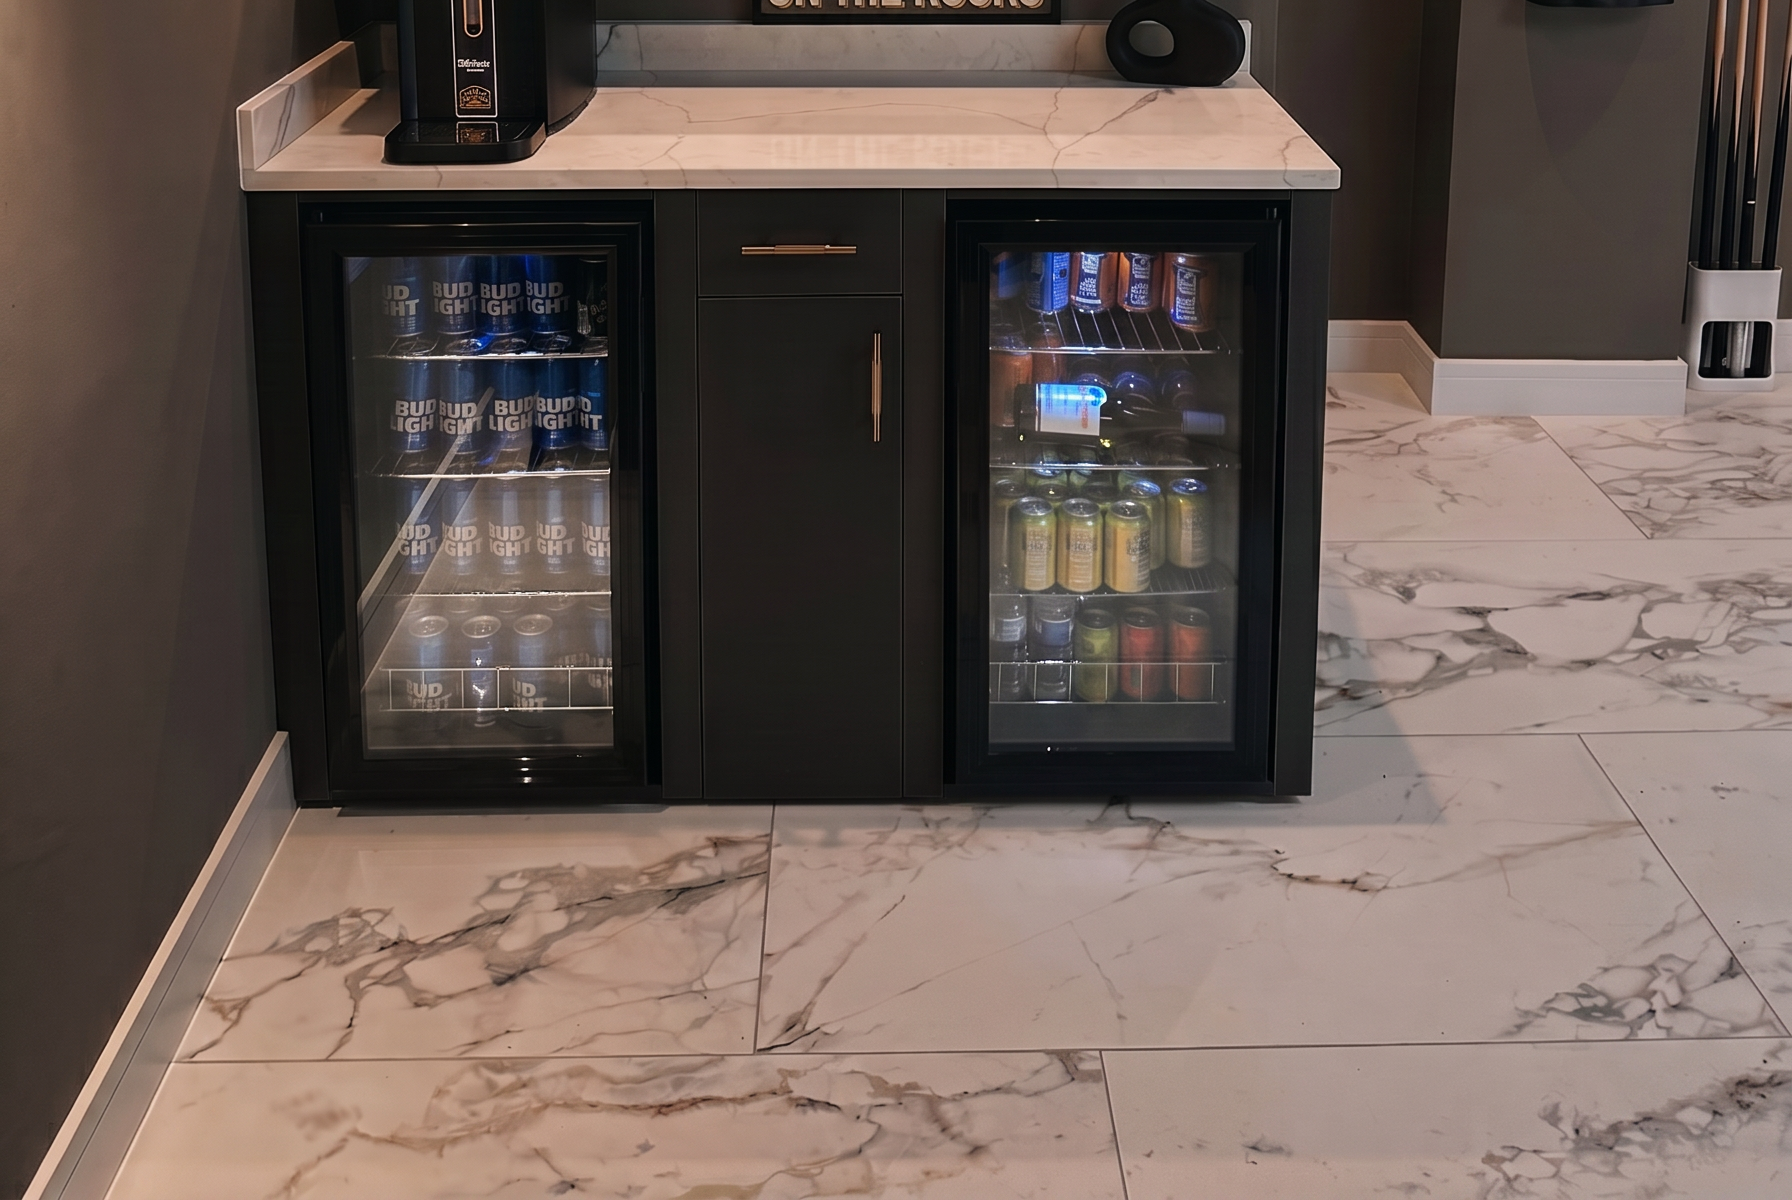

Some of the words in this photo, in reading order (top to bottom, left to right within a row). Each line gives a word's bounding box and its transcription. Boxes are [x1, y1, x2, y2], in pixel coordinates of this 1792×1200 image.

[381, 285, 410, 300] UD
[432, 281, 474, 299] BUD
[480, 282, 521, 299] BUD
[525, 280, 564, 298] BUD
[383, 298, 420, 316] GHT
[434, 295, 478, 315] IGHT
[481, 296, 524, 316] IGHT
[527, 295, 570, 315] IGHT
[395, 399, 437, 416] BUD
[439, 400, 477, 418] BUD
[494, 396, 534, 415] BUD
[536, 396, 576, 413] BUD
[390, 414, 434, 433] LIGH
[439, 415, 483, 435] IGHT
[489, 411, 533, 432] LIGH
[535, 410, 578, 430] IGHT
[397, 523, 431, 540] UD
[488, 521, 526, 541] BUD
[537, 522, 567, 540] UD
[400, 537, 438, 556] GHT
[445, 537, 483, 557] GHT
[489, 536, 532, 557] IGHT
[537, 537, 576, 556] GHT
[582, 538, 610, 557] IGH
[512, 677, 537, 697] UD
